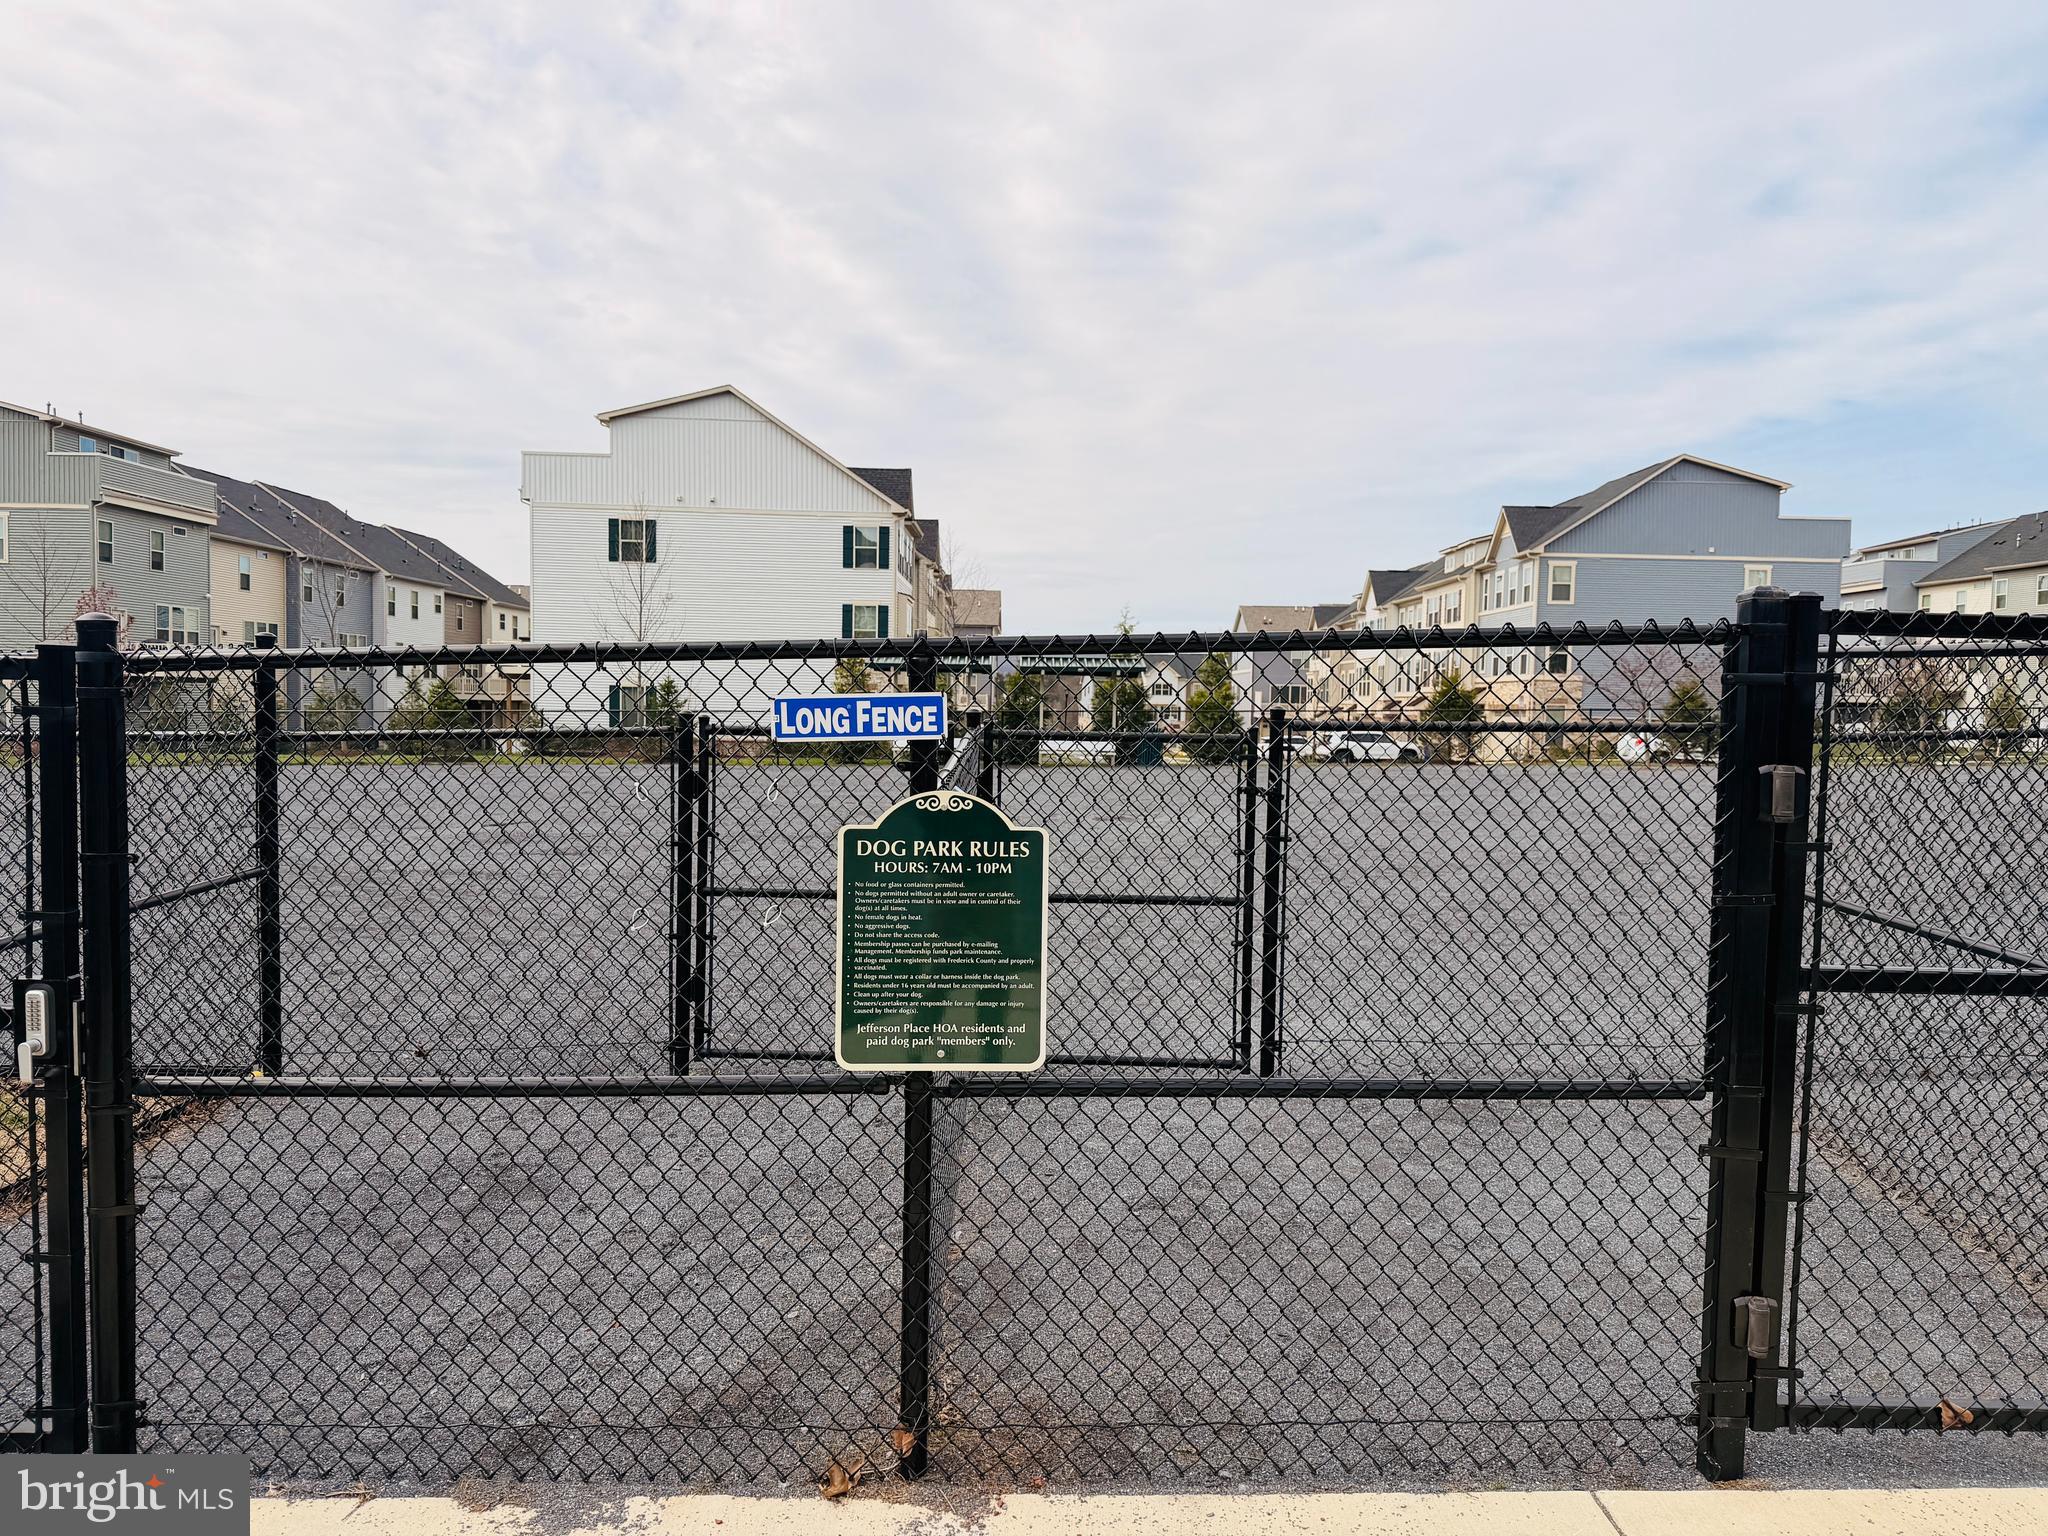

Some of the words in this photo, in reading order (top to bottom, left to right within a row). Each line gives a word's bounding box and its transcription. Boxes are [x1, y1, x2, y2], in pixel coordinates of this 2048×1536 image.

[780, 702, 850, 734] LONG
[856, 700, 937, 733] FENCE
[856, 840, 906, 857] DOG
[913, 840, 964, 857] PARK
[970, 841, 1030, 858] RULES
[874, 861, 928, 874] HOURS:
[932, 862, 963, 874] 7AM
[976, 863, 1012, 874] 10PM
[888, 881, 902, 889] glass
[934, 881, 965, 889] permitted.
[865, 890, 879, 898] dogs
[880, 890, 909, 898] permitted
[854, 905, 873, 913] dog(s)
[896, 923, 911, 931] dogs.
[932, 941, 962, 949] purchased
[963, 941, 971, 949] by
[971, 941, 999, 949] e-mailing
[863, 957, 878, 965] dogs
[902, 957, 932, 965] registered
[975, 958, 997, 966] County
[1010, 958, 1035, 966] properly
[910, 991, 923, 999] dog.
[920, 1000, 953, 1008] responsible
[856, 1023, 900, 1034] Jefferson
[903, 1023, 930, 1033] Place
[932, 1024, 958, 1033] HOA
[961, 1024, 1005, 1033] residents
[1007, 1024, 1026, 1033] and
[866, 1036, 888, 1048] paid
[890, 1036, 909, 1048] dog
[912, 1036, 934, 1048] park
[937, 1036, 990, 1046] "members"
[992, 1036, 1016, 1048] only.
